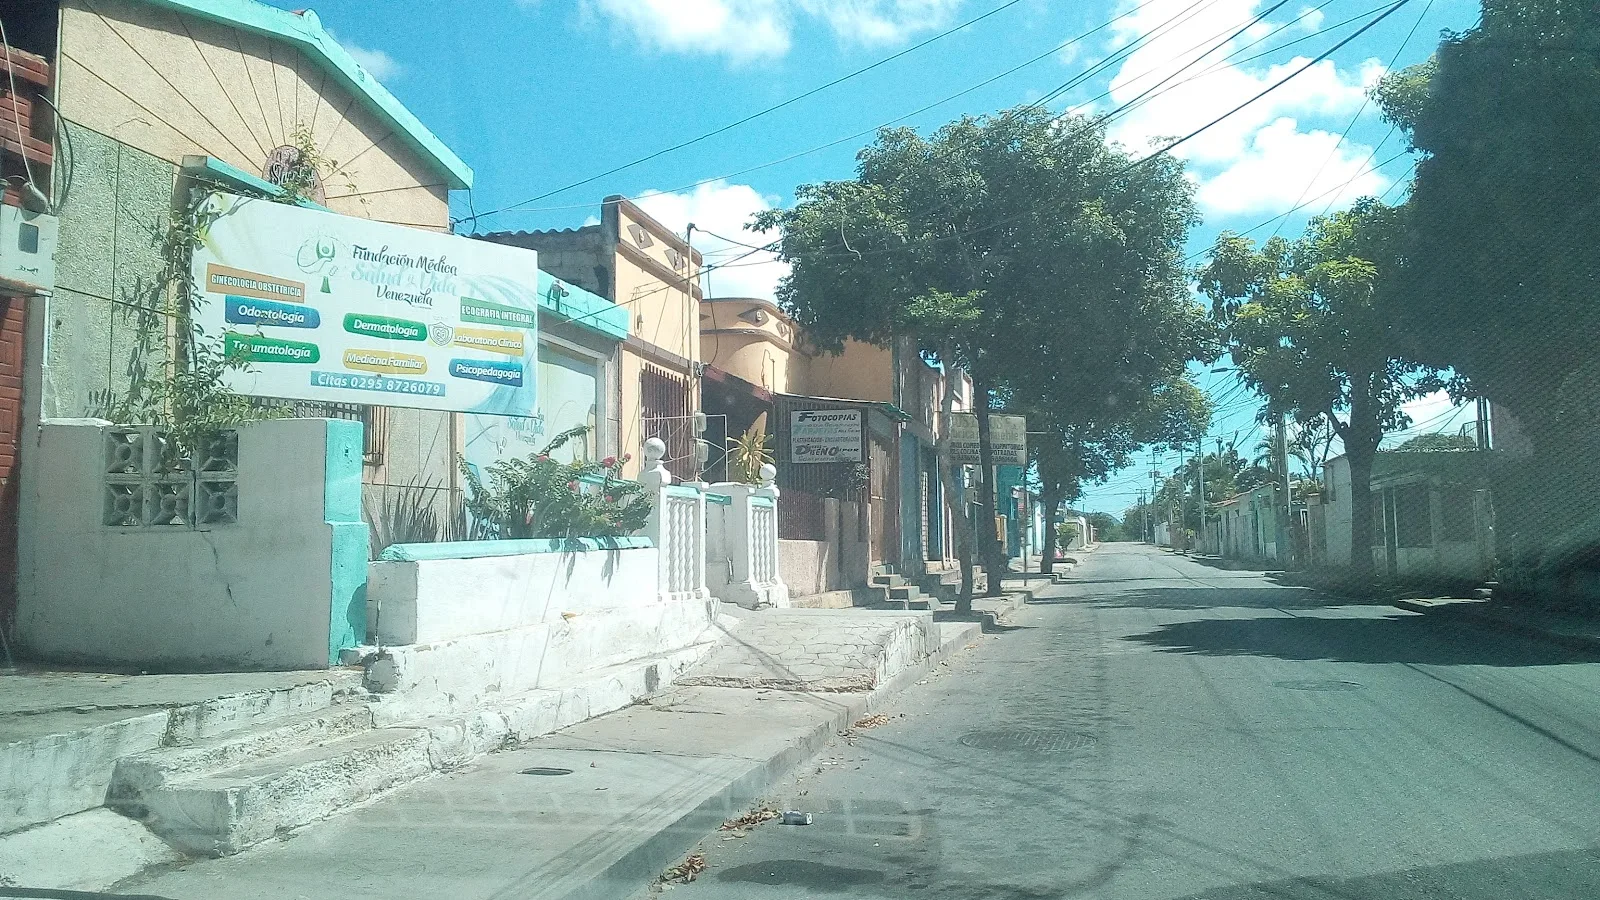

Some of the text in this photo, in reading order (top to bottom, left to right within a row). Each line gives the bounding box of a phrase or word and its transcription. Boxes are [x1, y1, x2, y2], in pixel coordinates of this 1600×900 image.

[416, 255, 458, 276] Médica
[258, 281, 302, 297] OBSTETRICIA
[351, 262, 409, 287] Salud
[419, 270, 457, 296] Vida
[376, 285, 433, 306] Venezuela
[461, 305, 534, 324] ECOGRAFIA INTEGRAL
[353, 318, 419, 338] Dermatología
[346, 352, 425, 369] Medicina Familiar
[456, 363, 521, 381] Psicopedagogía
[318, 373, 441, 394] Citas 0295 8726079
